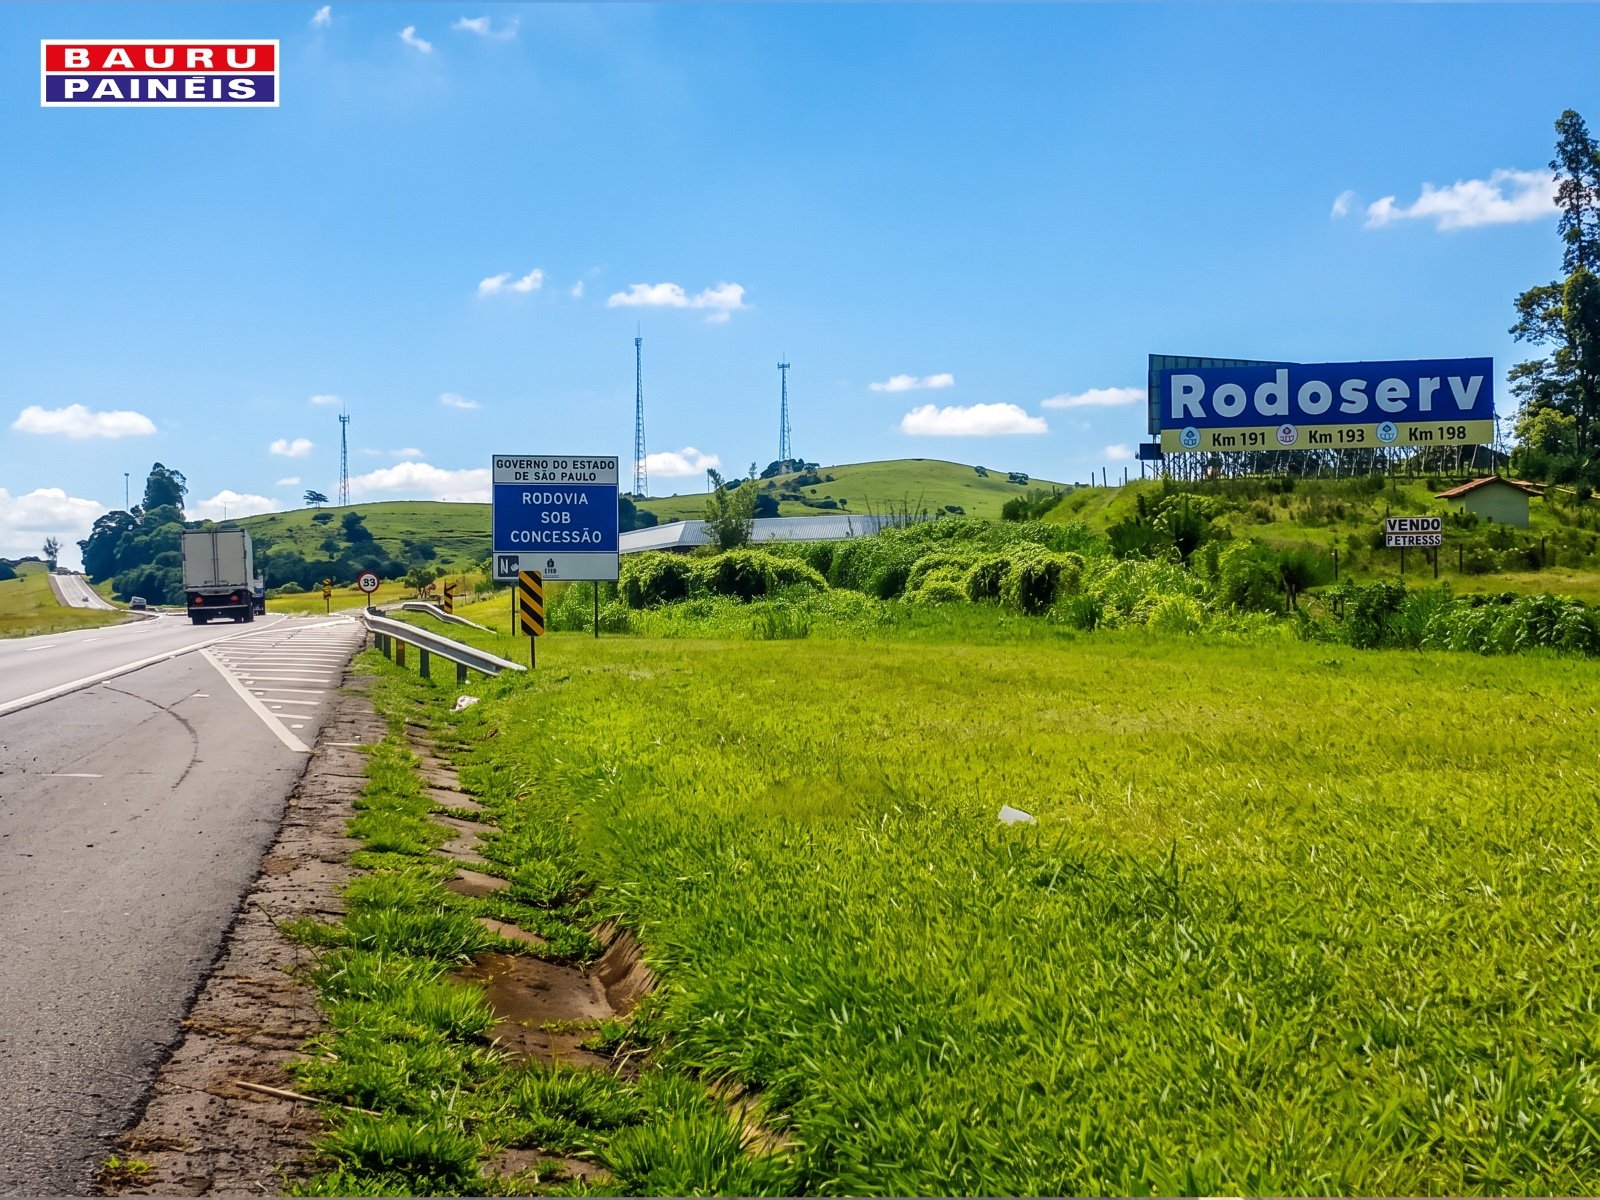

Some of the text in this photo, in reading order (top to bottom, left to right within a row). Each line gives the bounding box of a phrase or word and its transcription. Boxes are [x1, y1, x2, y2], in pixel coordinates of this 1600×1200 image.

[1170, 368, 1484, 418] Rodoserv
[1212, 432, 1236, 446] Km
[1240, 431, 1265, 446] 191
[1308, 430, 1332, 444] Km
[1337, 428, 1365, 443] 193
[1408, 427, 1433, 441] Km
[1437, 425, 1467, 440] 198
[496, 459, 615, 470] GOVERNO DO ESTADO
[514, 470, 596, 481] DE SÃO PAULO
[522, 492, 588, 505] RODOVIA
[541, 512, 571, 524] SOB
[1387, 518, 1440, 531] VENDO
[510, 528, 602, 543] CONCESSÃO
